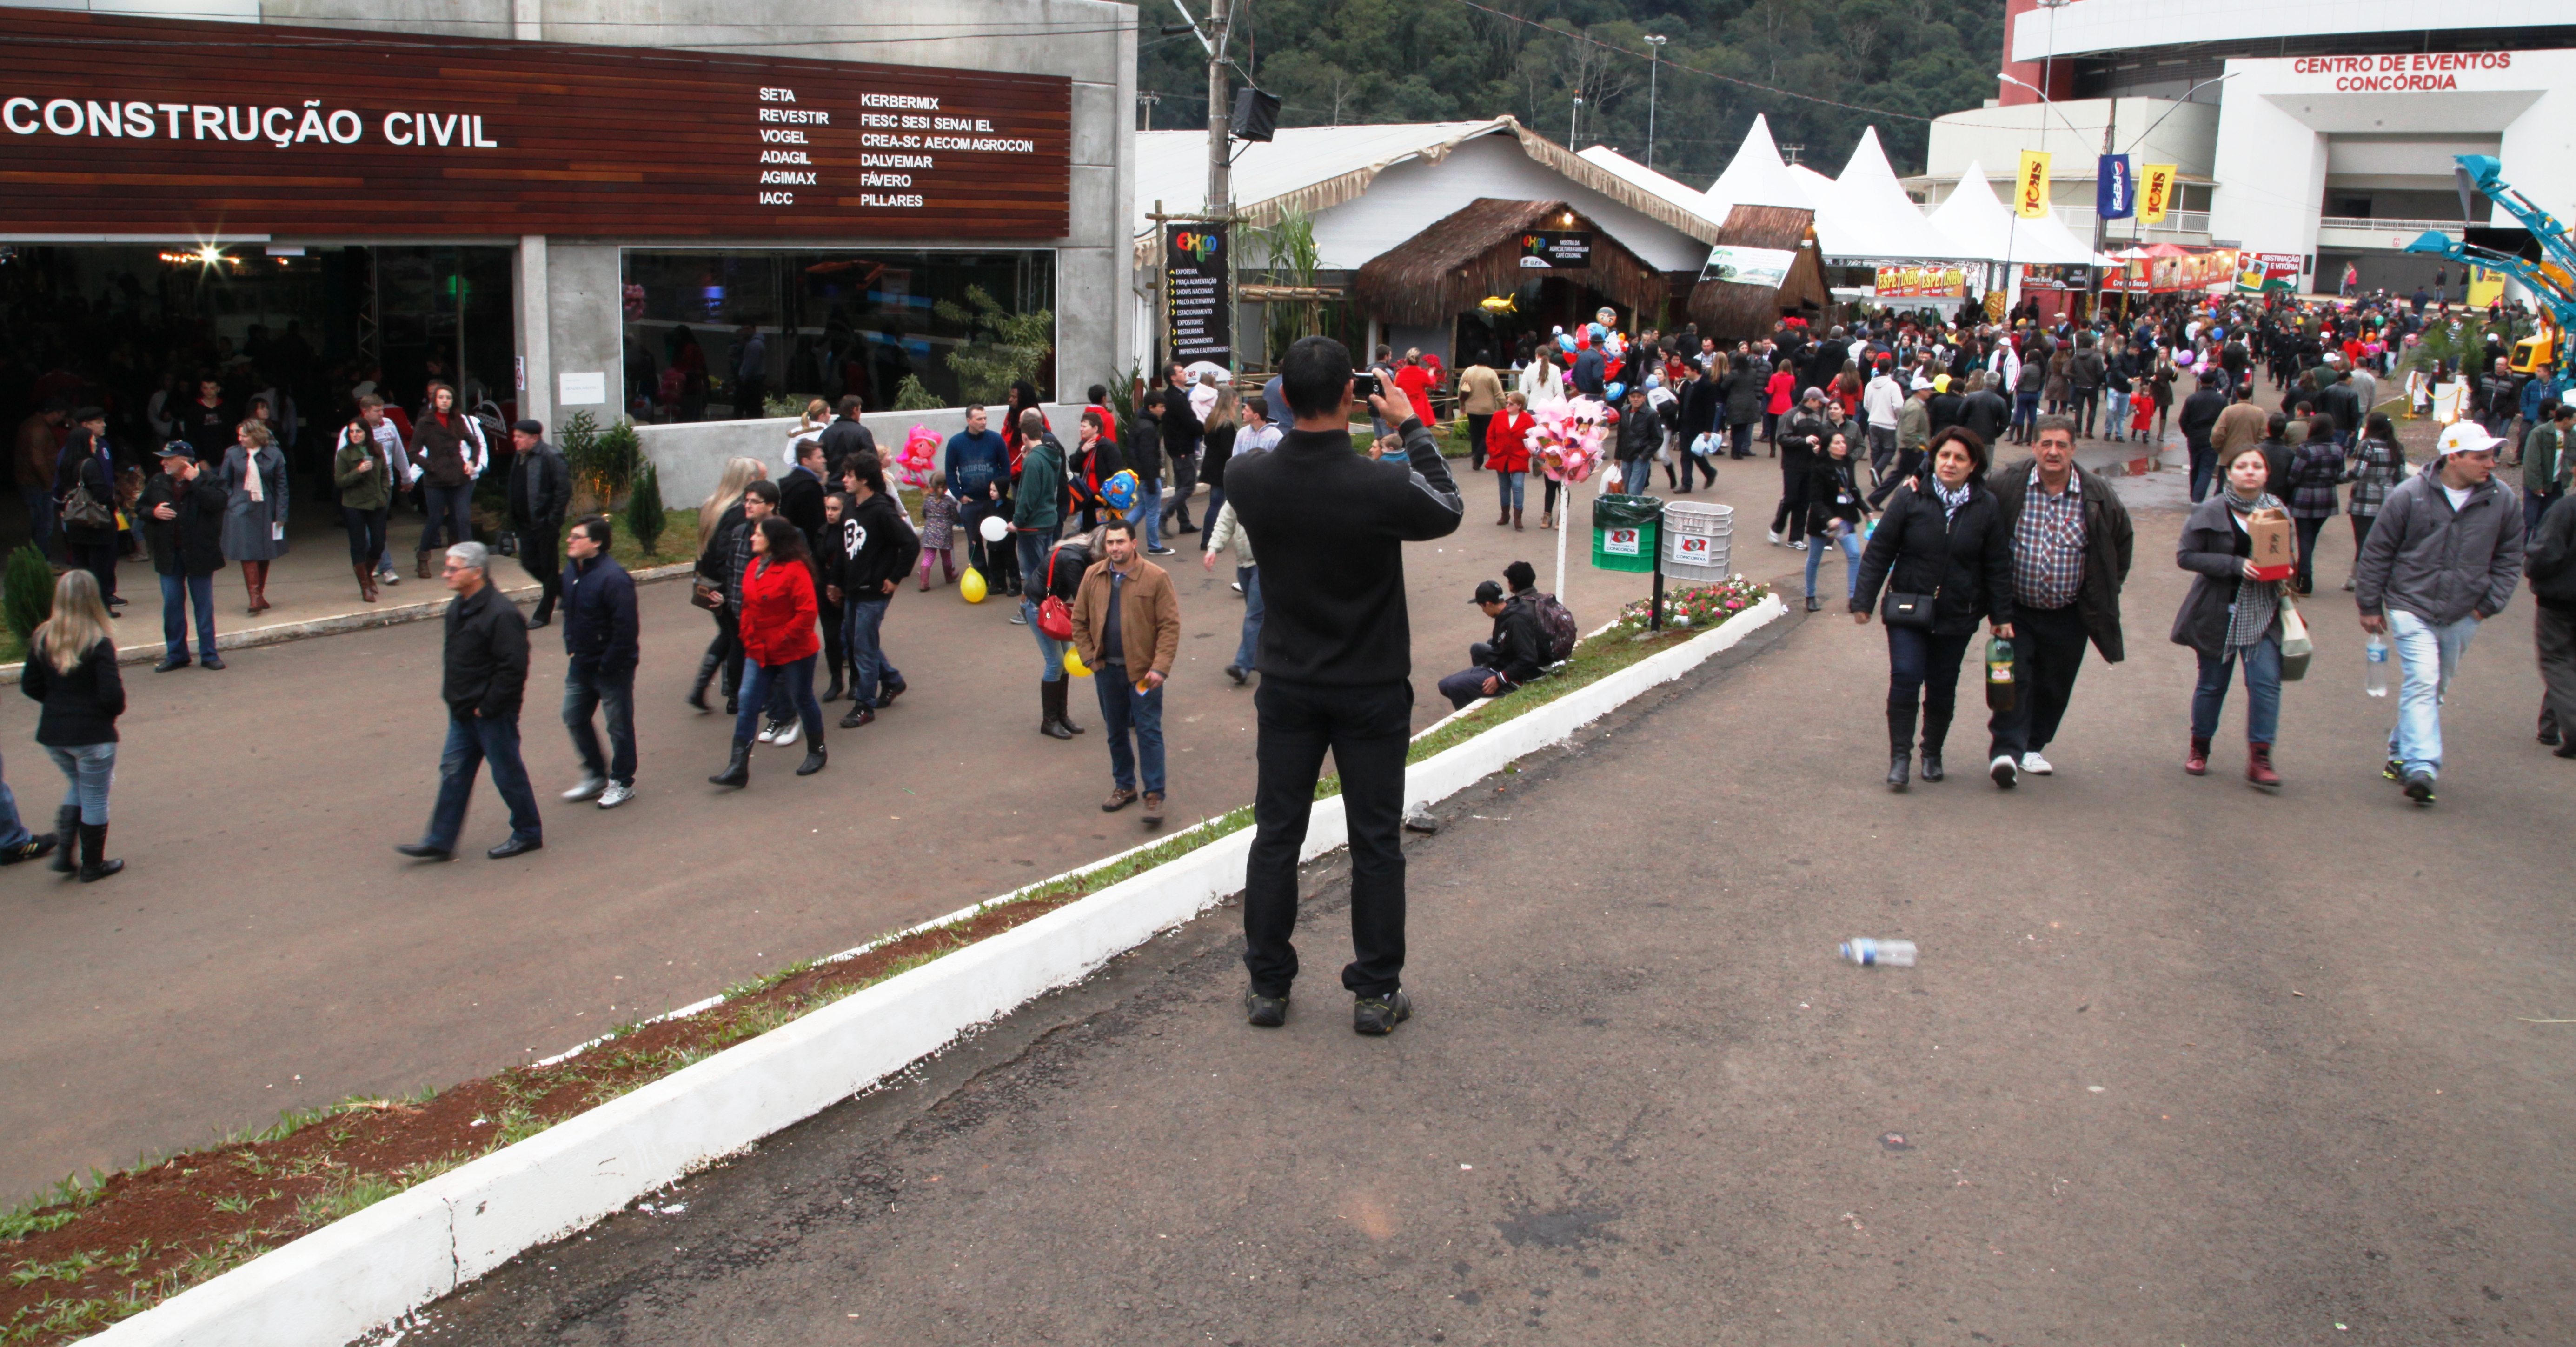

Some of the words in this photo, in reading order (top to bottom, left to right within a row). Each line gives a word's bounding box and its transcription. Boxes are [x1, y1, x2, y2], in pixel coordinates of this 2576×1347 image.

[2294, 57, 2373, 73] CENTRO
[2379, 56, 2406, 72] DE
[2412, 53, 2510, 70] EVENTOS
[2336, 73, 2456, 91] CONCÓRDIA
[759, 87, 796, 102] SETA
[861, 93, 939, 110] KERBERMIX
[3, 98, 362, 148] CONSTRUÇÃO
[384, 112, 497, 147] CIVIL
[759, 108, 829, 124] REVESTIR
[861, 113, 898, 127] FIESC
[901, 115, 930, 129] SESI
[934, 117, 971, 131] SENAI
[976, 120, 994, 132] IEL
[760, 129, 809, 144] VOGEL
[861, 133, 921, 148] CREA-SC
[760, 150, 812, 164] ADAGIL
[861, 153, 933, 168] DALVEMAR
[760, 171, 816, 185] AGIMAX
[861, 171, 911, 187] FÁVERO
[760, 192, 793, 205] IACC
[861, 194, 923, 207] PILLARES
[2112, 175, 2123, 211] PEPSI
[2261, 254, 2299, 263] OBSTINAÇÃO
[2275, 262, 2299, 270] VITÓRIA
